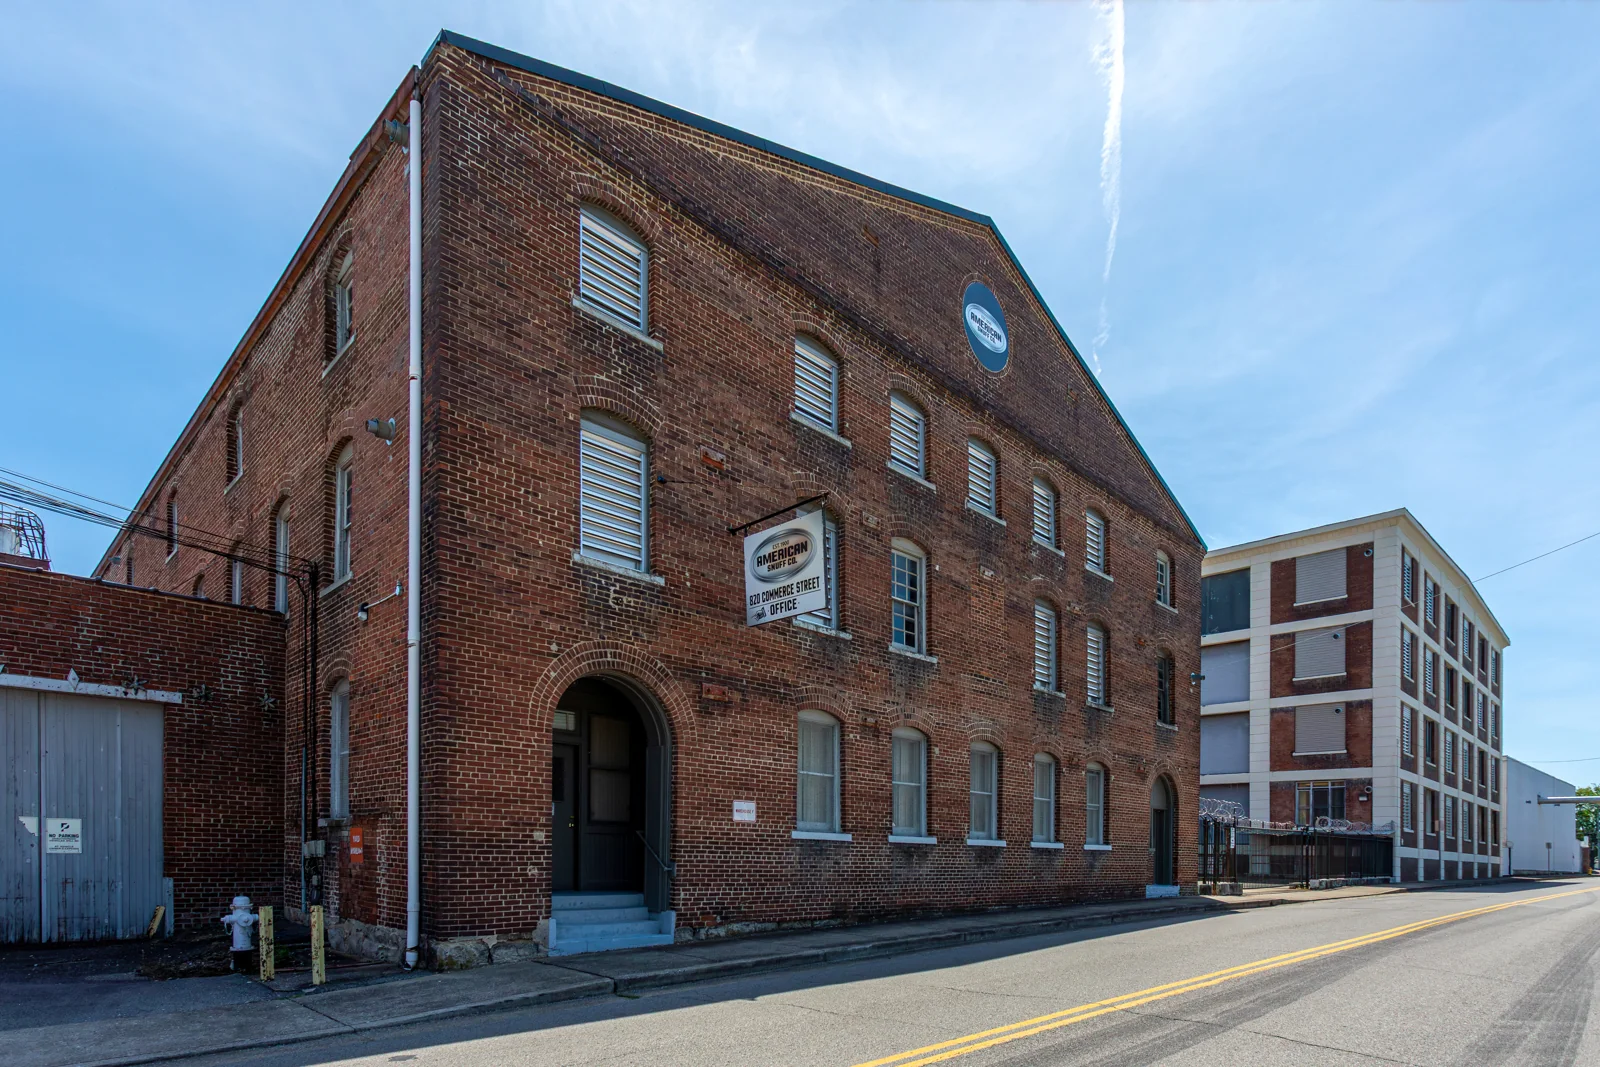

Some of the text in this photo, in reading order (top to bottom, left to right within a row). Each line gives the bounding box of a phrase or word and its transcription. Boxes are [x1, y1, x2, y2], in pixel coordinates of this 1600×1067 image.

[970, 312, 1002, 343] AMERICAN
[756, 541, 808, 567] AMERICAN
[767, 556, 798, 572] SNUFF CO.
[749, 576, 820, 606] 820 COMMERCE STREET
[770, 598, 797, 615] OFFICE
